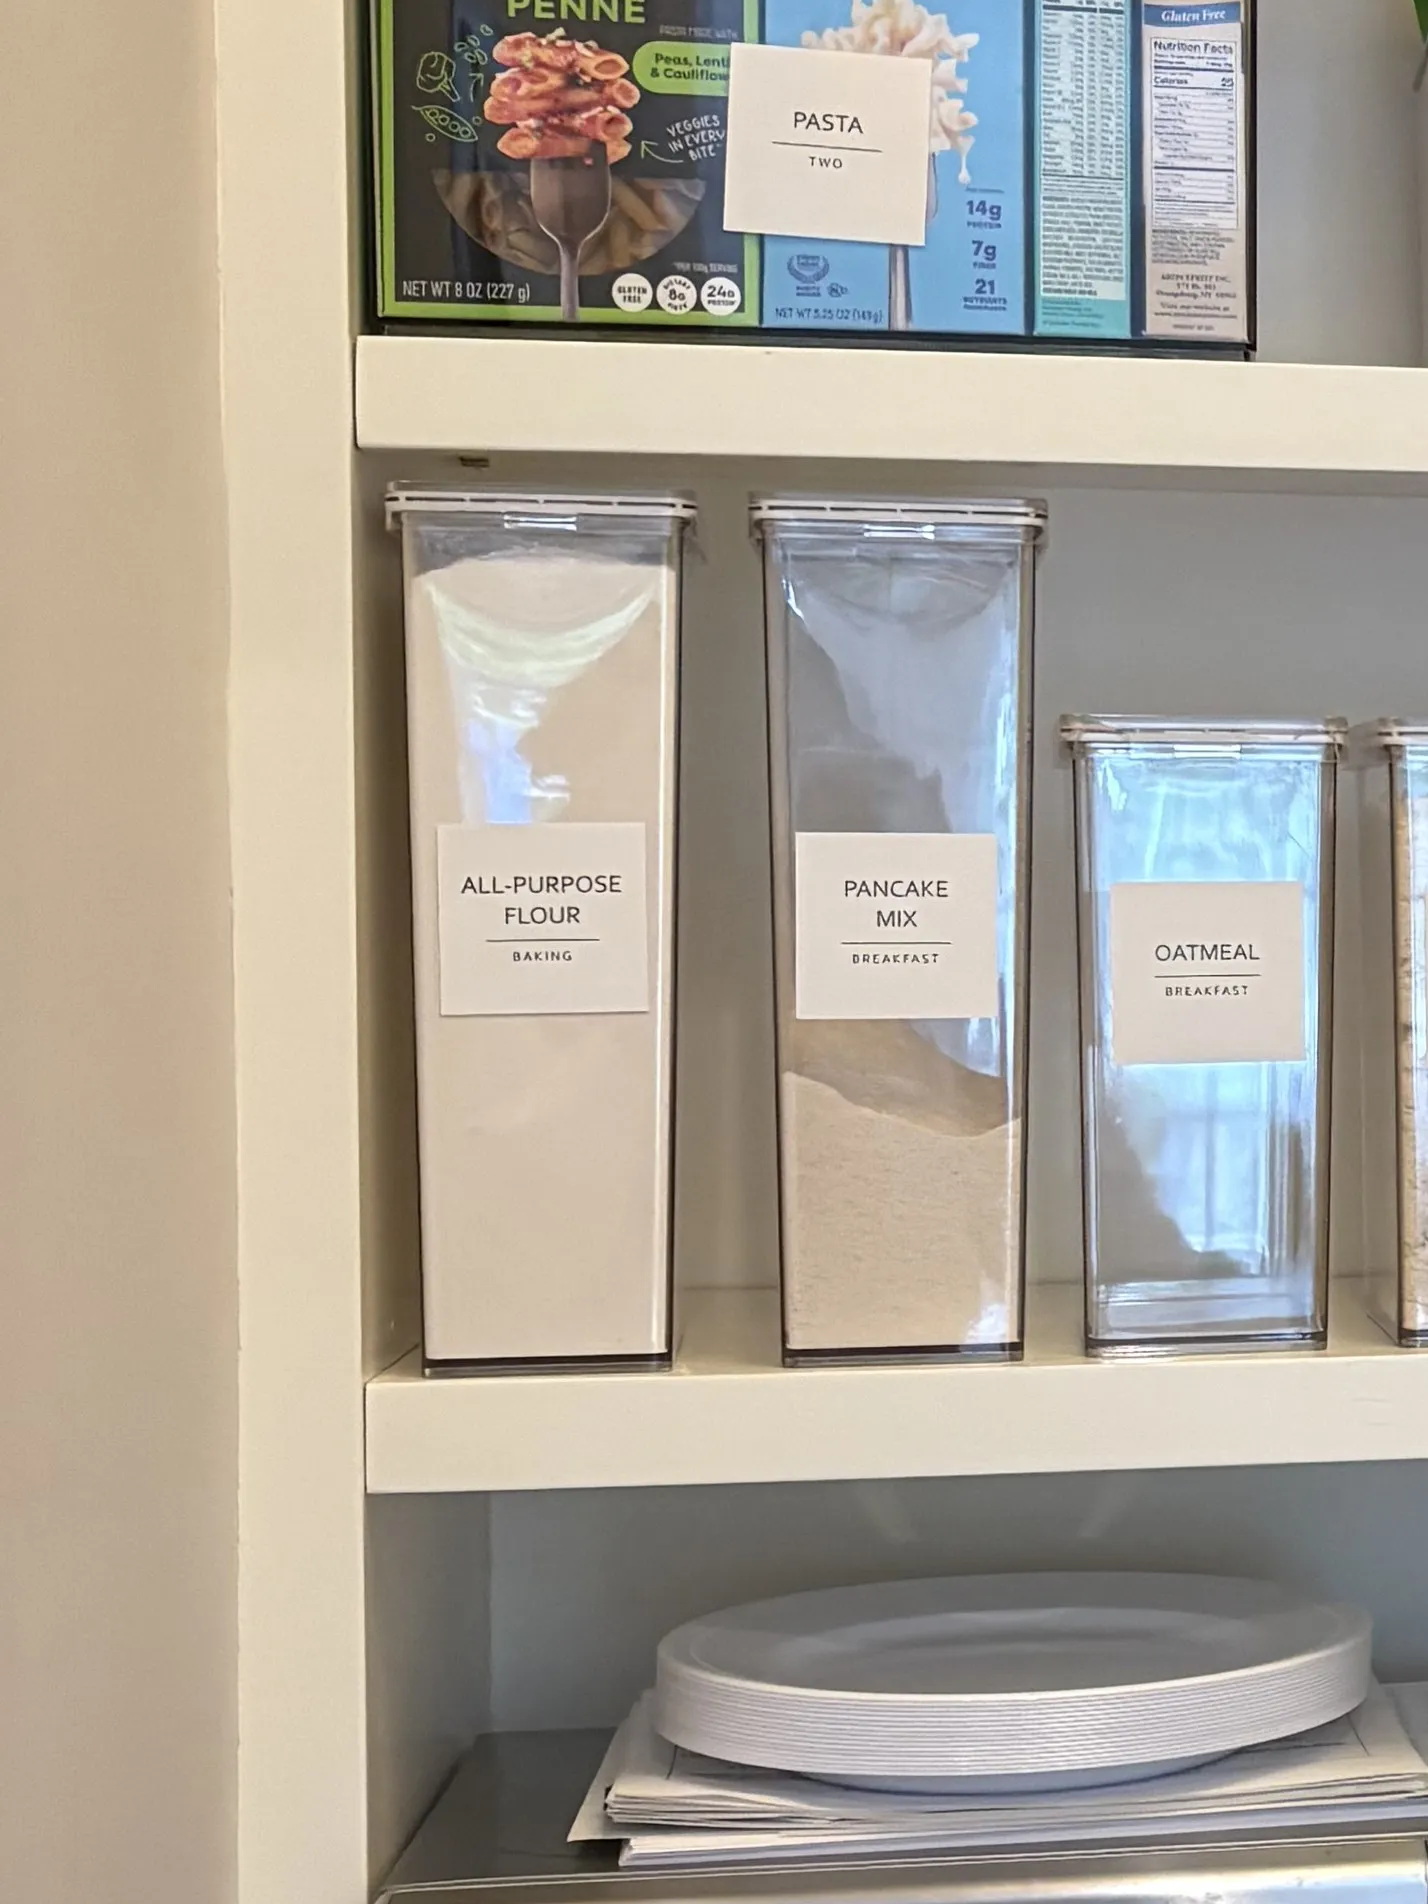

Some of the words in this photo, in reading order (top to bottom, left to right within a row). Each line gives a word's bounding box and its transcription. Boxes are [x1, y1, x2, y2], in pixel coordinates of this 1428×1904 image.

[655, 52, 693, 69] Peas,
[650, 66, 660, 78] &
[666, 115, 721, 138] VEGGIES
[793, 111, 864, 134] PASTA
[668, 139, 682, 154] IN
[685, 129, 726, 149] EVERY
[808, 156, 843, 169] TWO
[966, 199, 1002, 222] 14g
[971, 240, 997, 261] 7g
[402, 280, 428, 298] NET
[430, 280, 453, 298] WT
[454, 280, 463, 298] 8
[464, 281, 483, 299] OZ
[486, 280, 515, 301] (227
[516, 282, 532, 304] g)
[975, 278, 995, 295] 21
[461, 875, 623, 894] ALL-PURPOSE
[843, 879, 950, 899] PANCAKE
[504, 906, 581, 925] FLOUR
[876, 909, 919, 930] MIX
[512, 950, 573, 962] BAKING
[851, 951, 941, 965] BREAKFAST
[1154, 941, 1262, 964] OATMEAL
[1163, 984, 1250, 998] BREAKFAST
